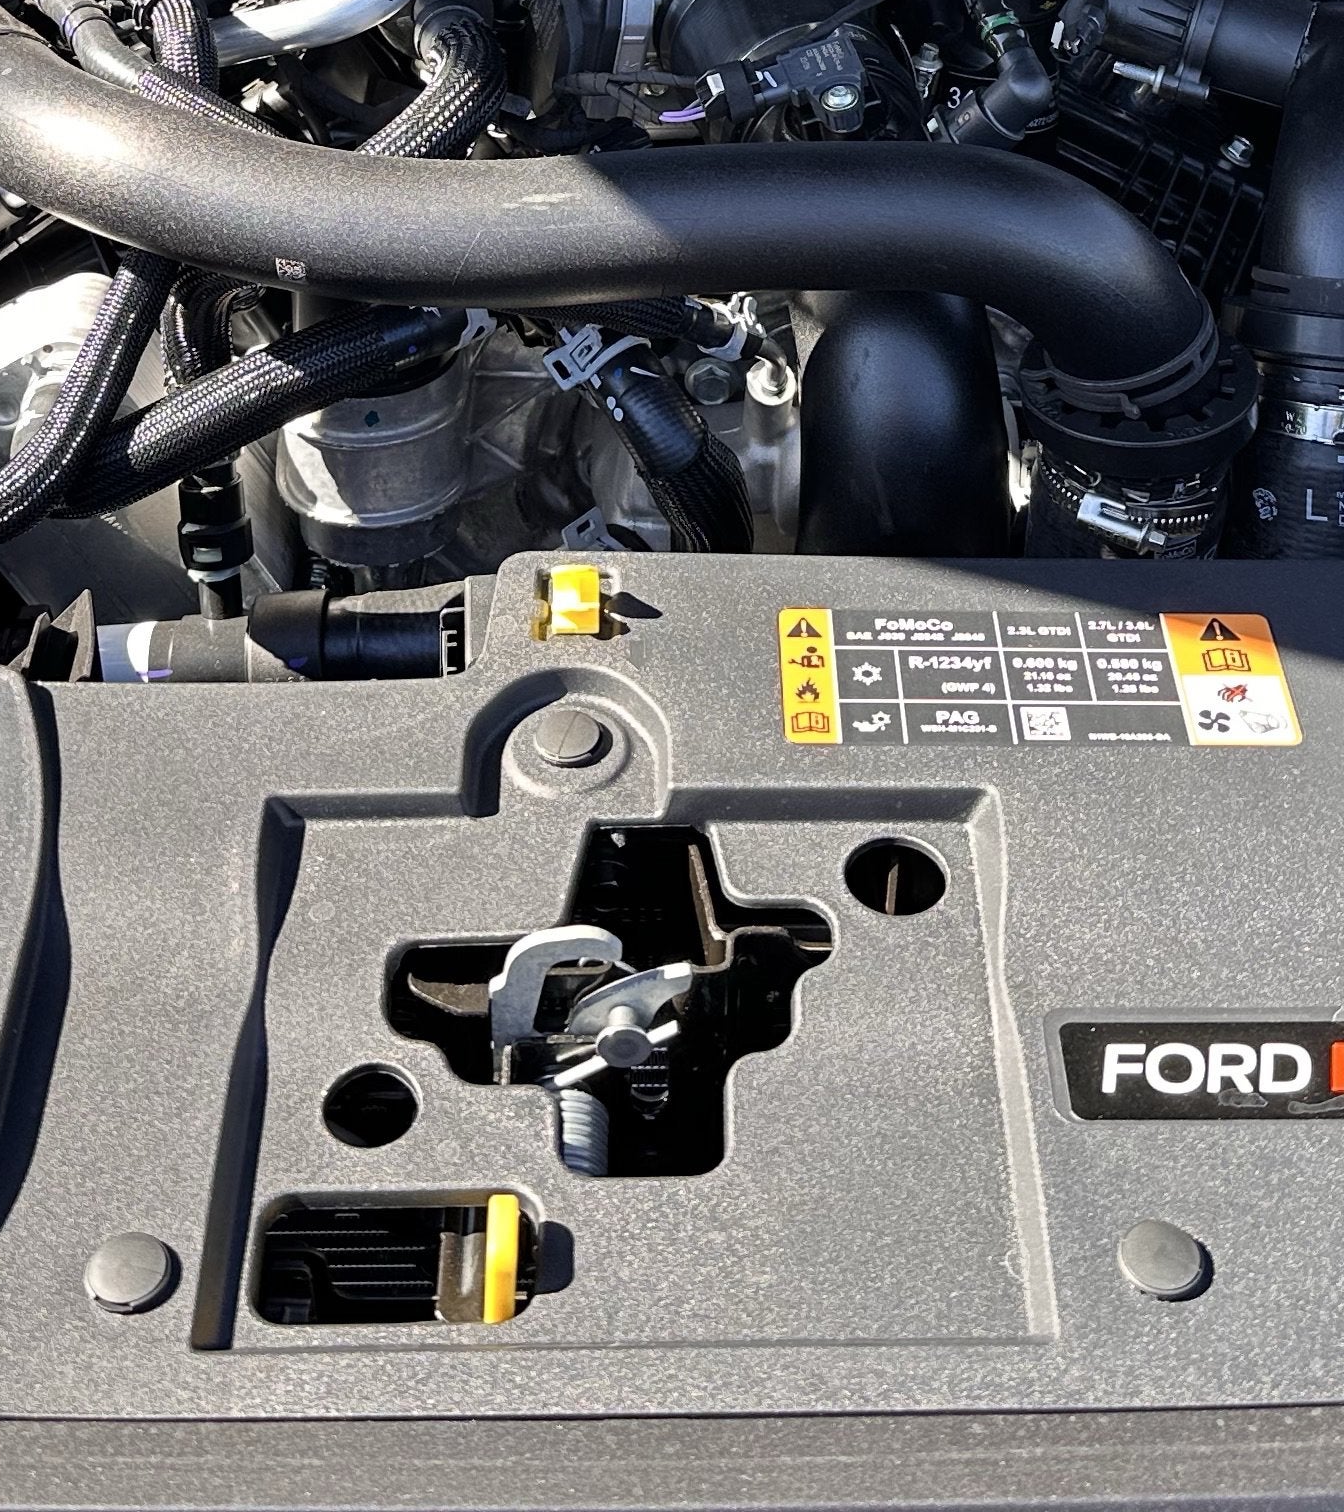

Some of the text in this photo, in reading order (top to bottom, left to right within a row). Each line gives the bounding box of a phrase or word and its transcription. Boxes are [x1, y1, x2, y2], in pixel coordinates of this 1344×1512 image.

[1306, 489, 1328, 521] L
[874, 618, 954, 631] FoMoCo
[908, 655, 992, 672] R-1234yf
[1057, 657, 1078, 671] kg
[1142, 657, 1163, 672] kg
[982, 682, 996, 695] 4)
[935, 710, 980, 724] PAG
[1101, 1041, 1313, 1094] FORD
